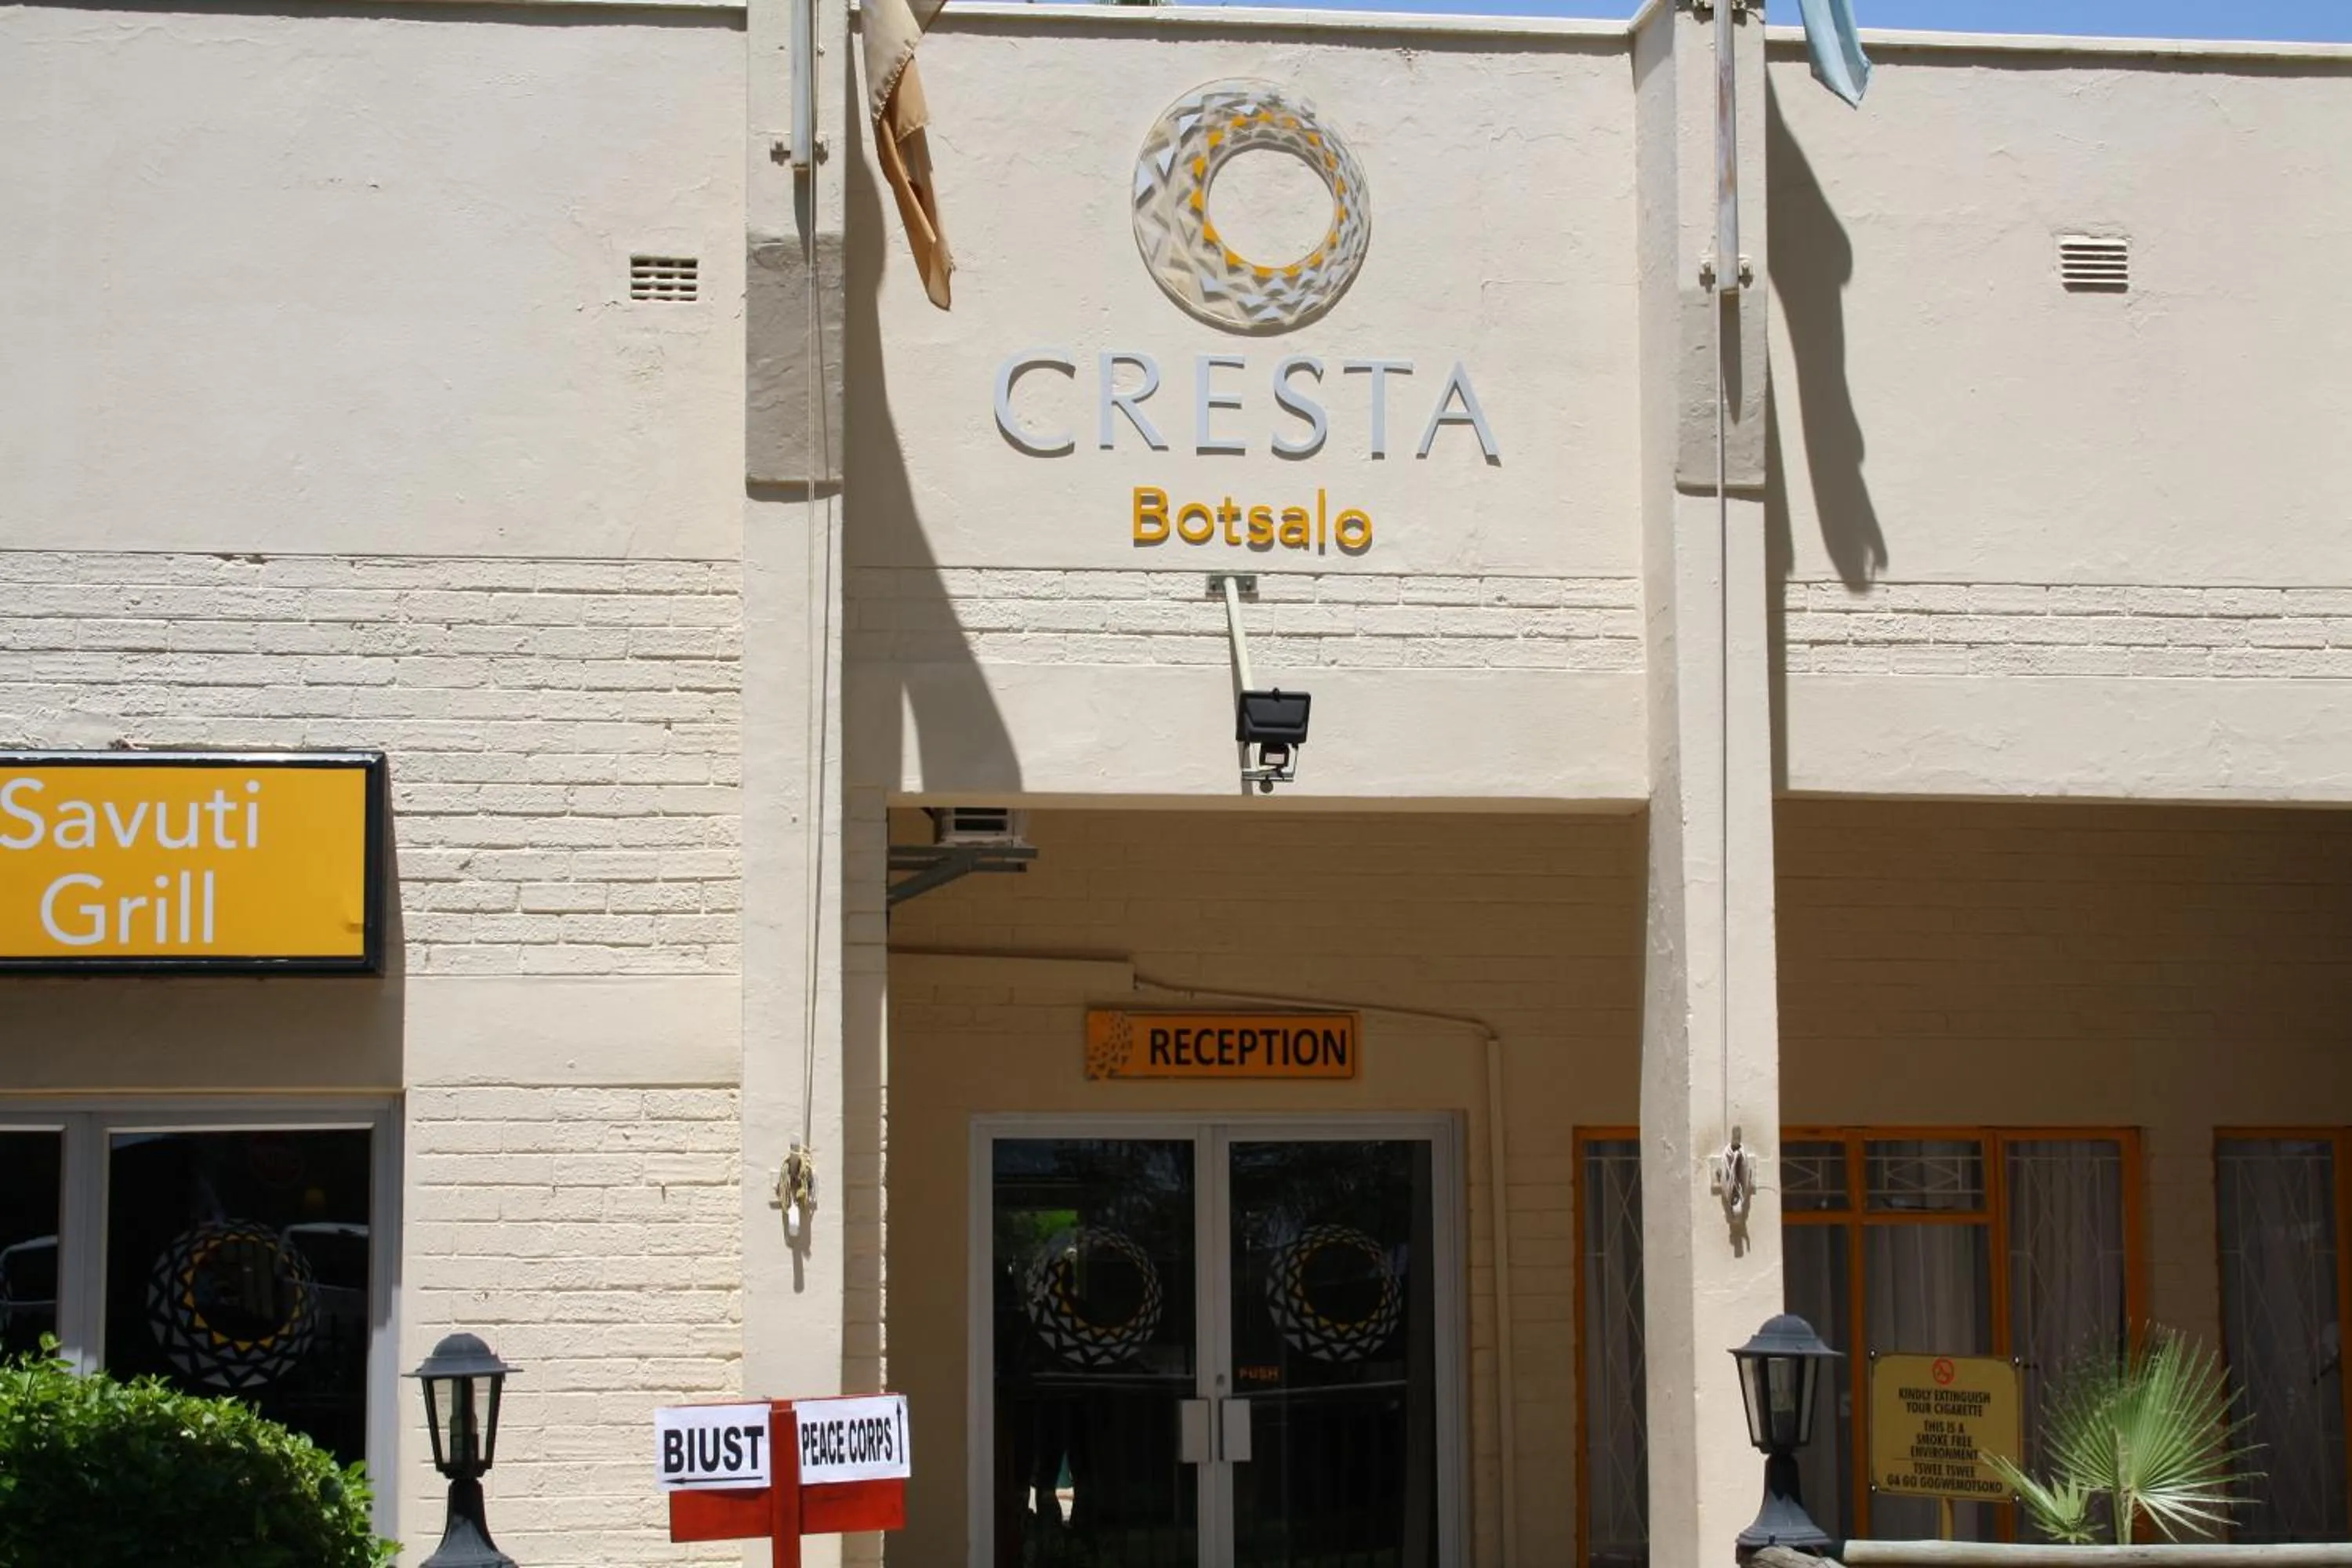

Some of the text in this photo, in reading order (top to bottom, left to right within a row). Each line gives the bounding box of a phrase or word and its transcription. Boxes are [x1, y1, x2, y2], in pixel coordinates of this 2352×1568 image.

[993, 347, 1501, 466] CRESTA
[1133, 487, 1373, 552] Botsalo
[0, 777, 261, 850] Savuti
[40, 869, 214, 946] Grill
[1149, 1028, 1347, 1066] RECEPTION
[1239, 1367, 1279, 1380] PUSH
[1898, 1388, 1991, 1404] KINDLY EXTINGUISH
[1906, 1402, 1983, 1417] YOUR CIGARETTE
[1916, 1433, 1973, 1448] SMOKE FREE
[1923, 1420, 1965, 1434] THIS IS A
[664, 1425, 764, 1473] BIUST
[800, 1417, 893, 1466] PEACE CORPS
[1911, 1446, 1978, 1461] ENVIRONMENT
[1887, 1474, 1900, 1486] GA
